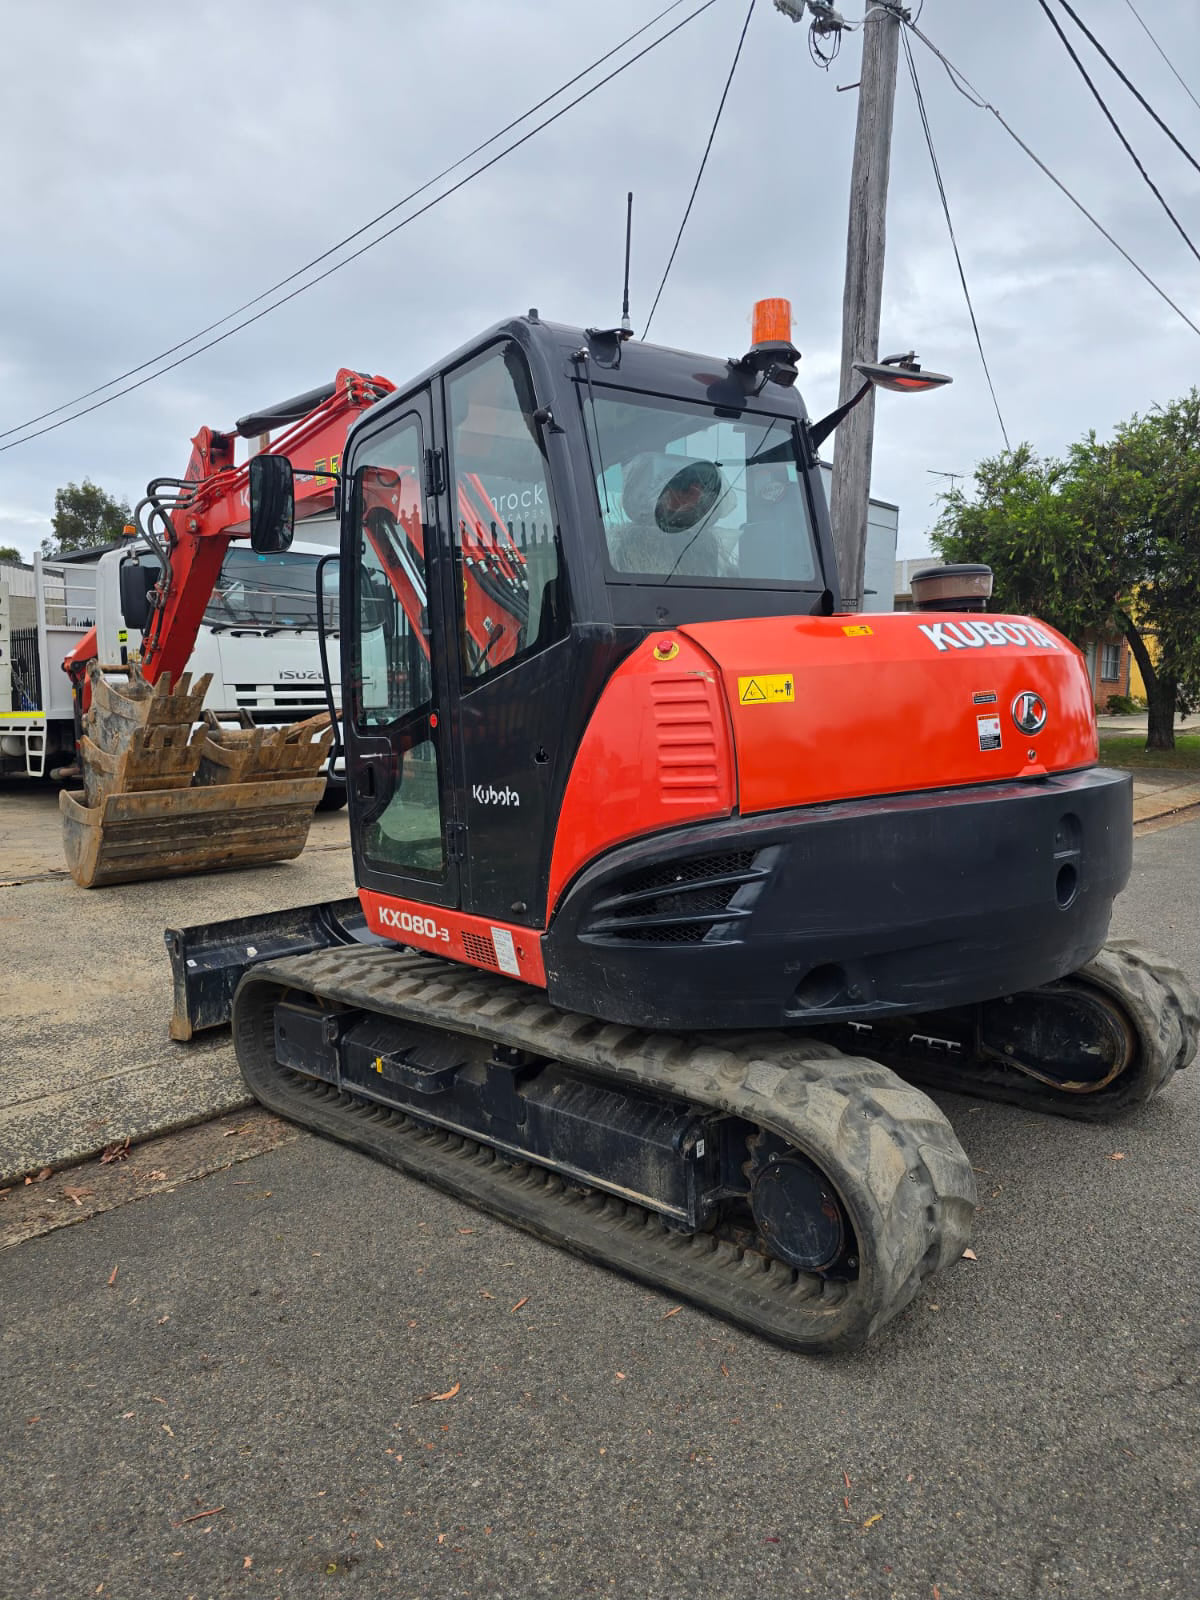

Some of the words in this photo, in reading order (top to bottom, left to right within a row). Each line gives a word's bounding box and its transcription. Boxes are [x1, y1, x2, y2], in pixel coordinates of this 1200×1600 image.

[917, 620, 1060, 651] KUBOTA
[472, 784, 520, 806] Kubota
[378, 906, 450, 942] KX080-3
